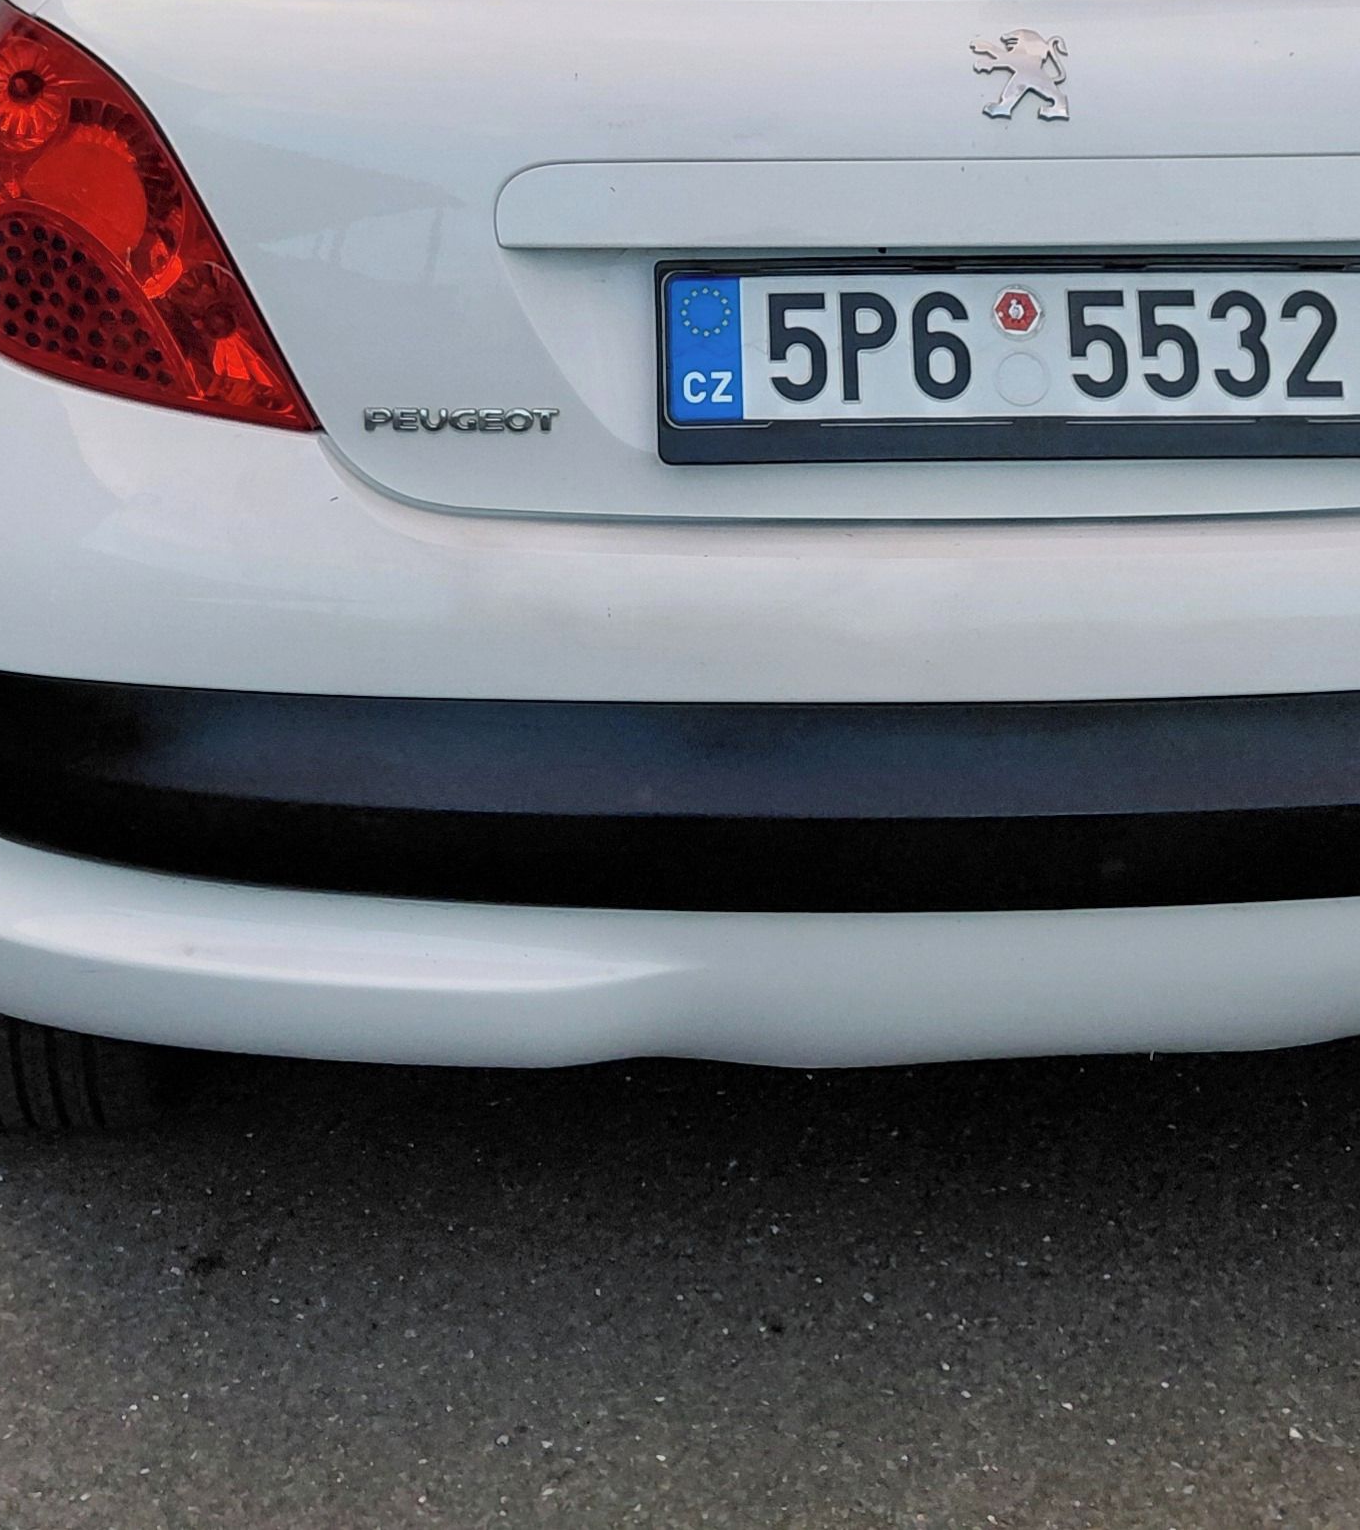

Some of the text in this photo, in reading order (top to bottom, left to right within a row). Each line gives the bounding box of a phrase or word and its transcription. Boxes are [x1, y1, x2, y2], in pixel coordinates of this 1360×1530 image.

[767, 289, 1344, 402] 5P6 5532
[683, 371, 734, 404] CZ
[363, 406, 560, 432] PEUGEOT
